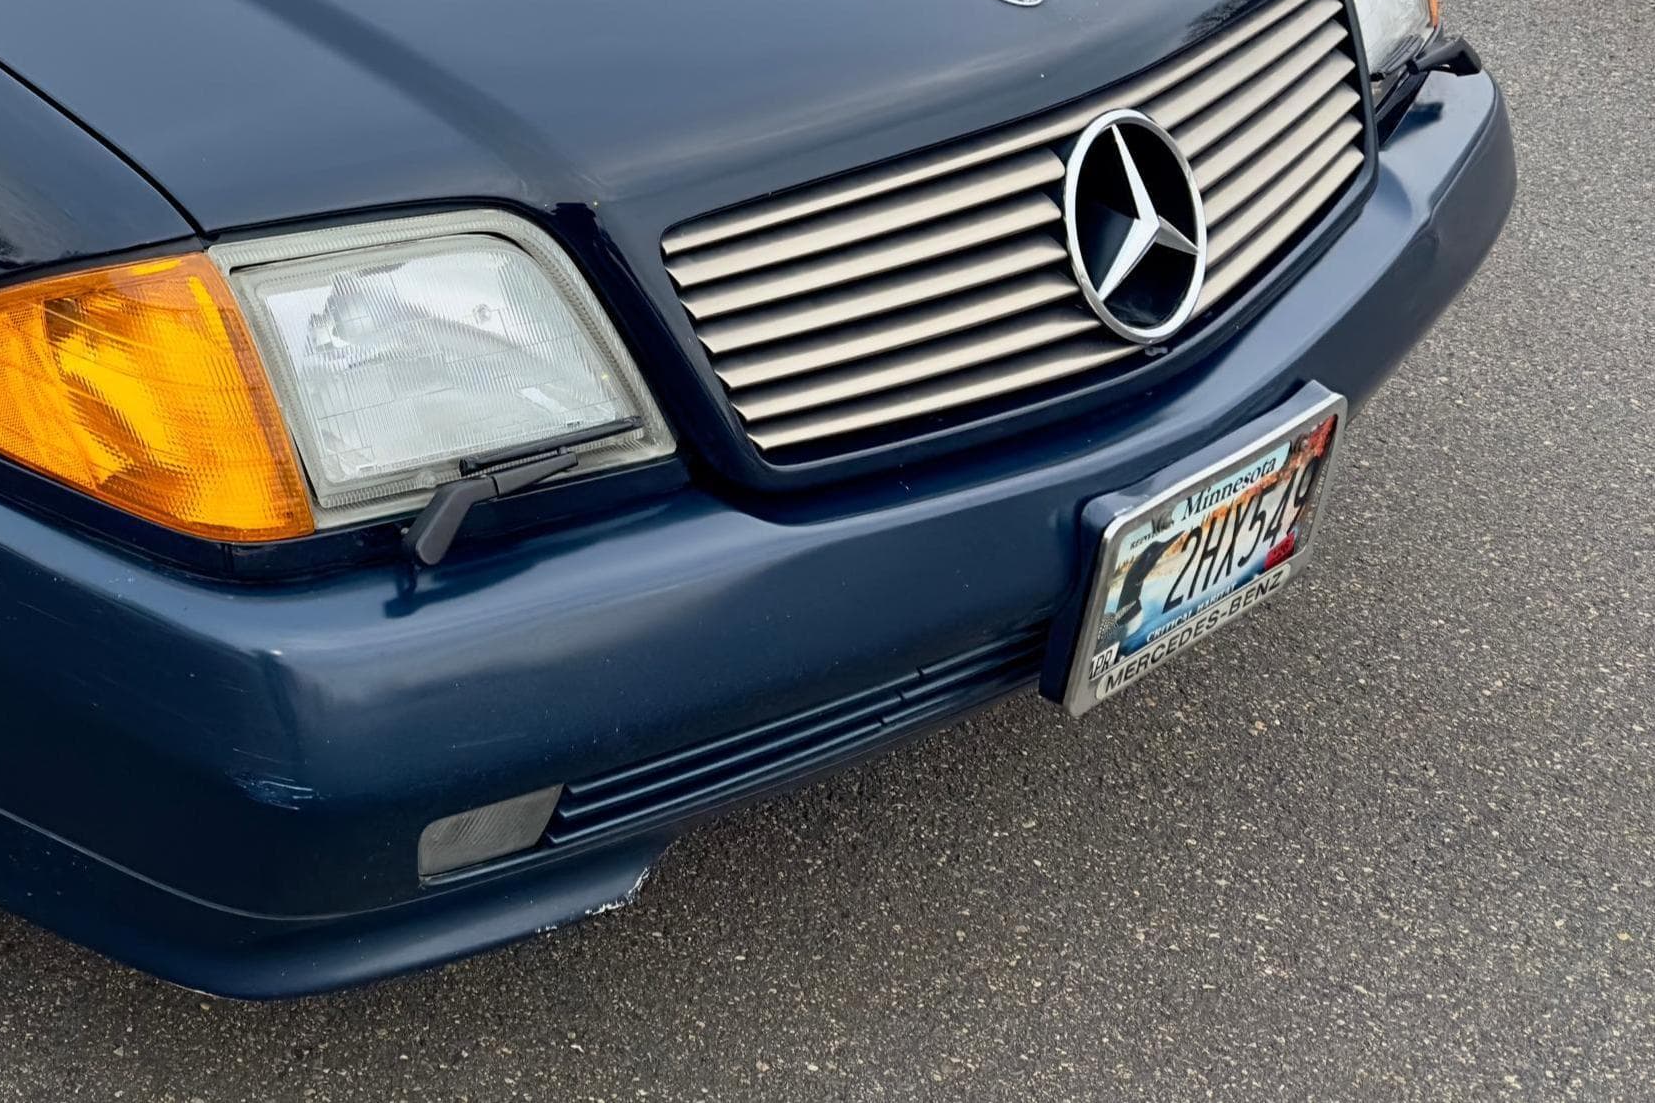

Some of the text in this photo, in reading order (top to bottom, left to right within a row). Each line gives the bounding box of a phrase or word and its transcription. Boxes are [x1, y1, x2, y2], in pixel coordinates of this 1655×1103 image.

[1163, 456, 1320, 613] 2HX549
[1182, 457, 1276, 522] Minnesota
[1106, 570, 1283, 693] MERCEDES-BENZ
